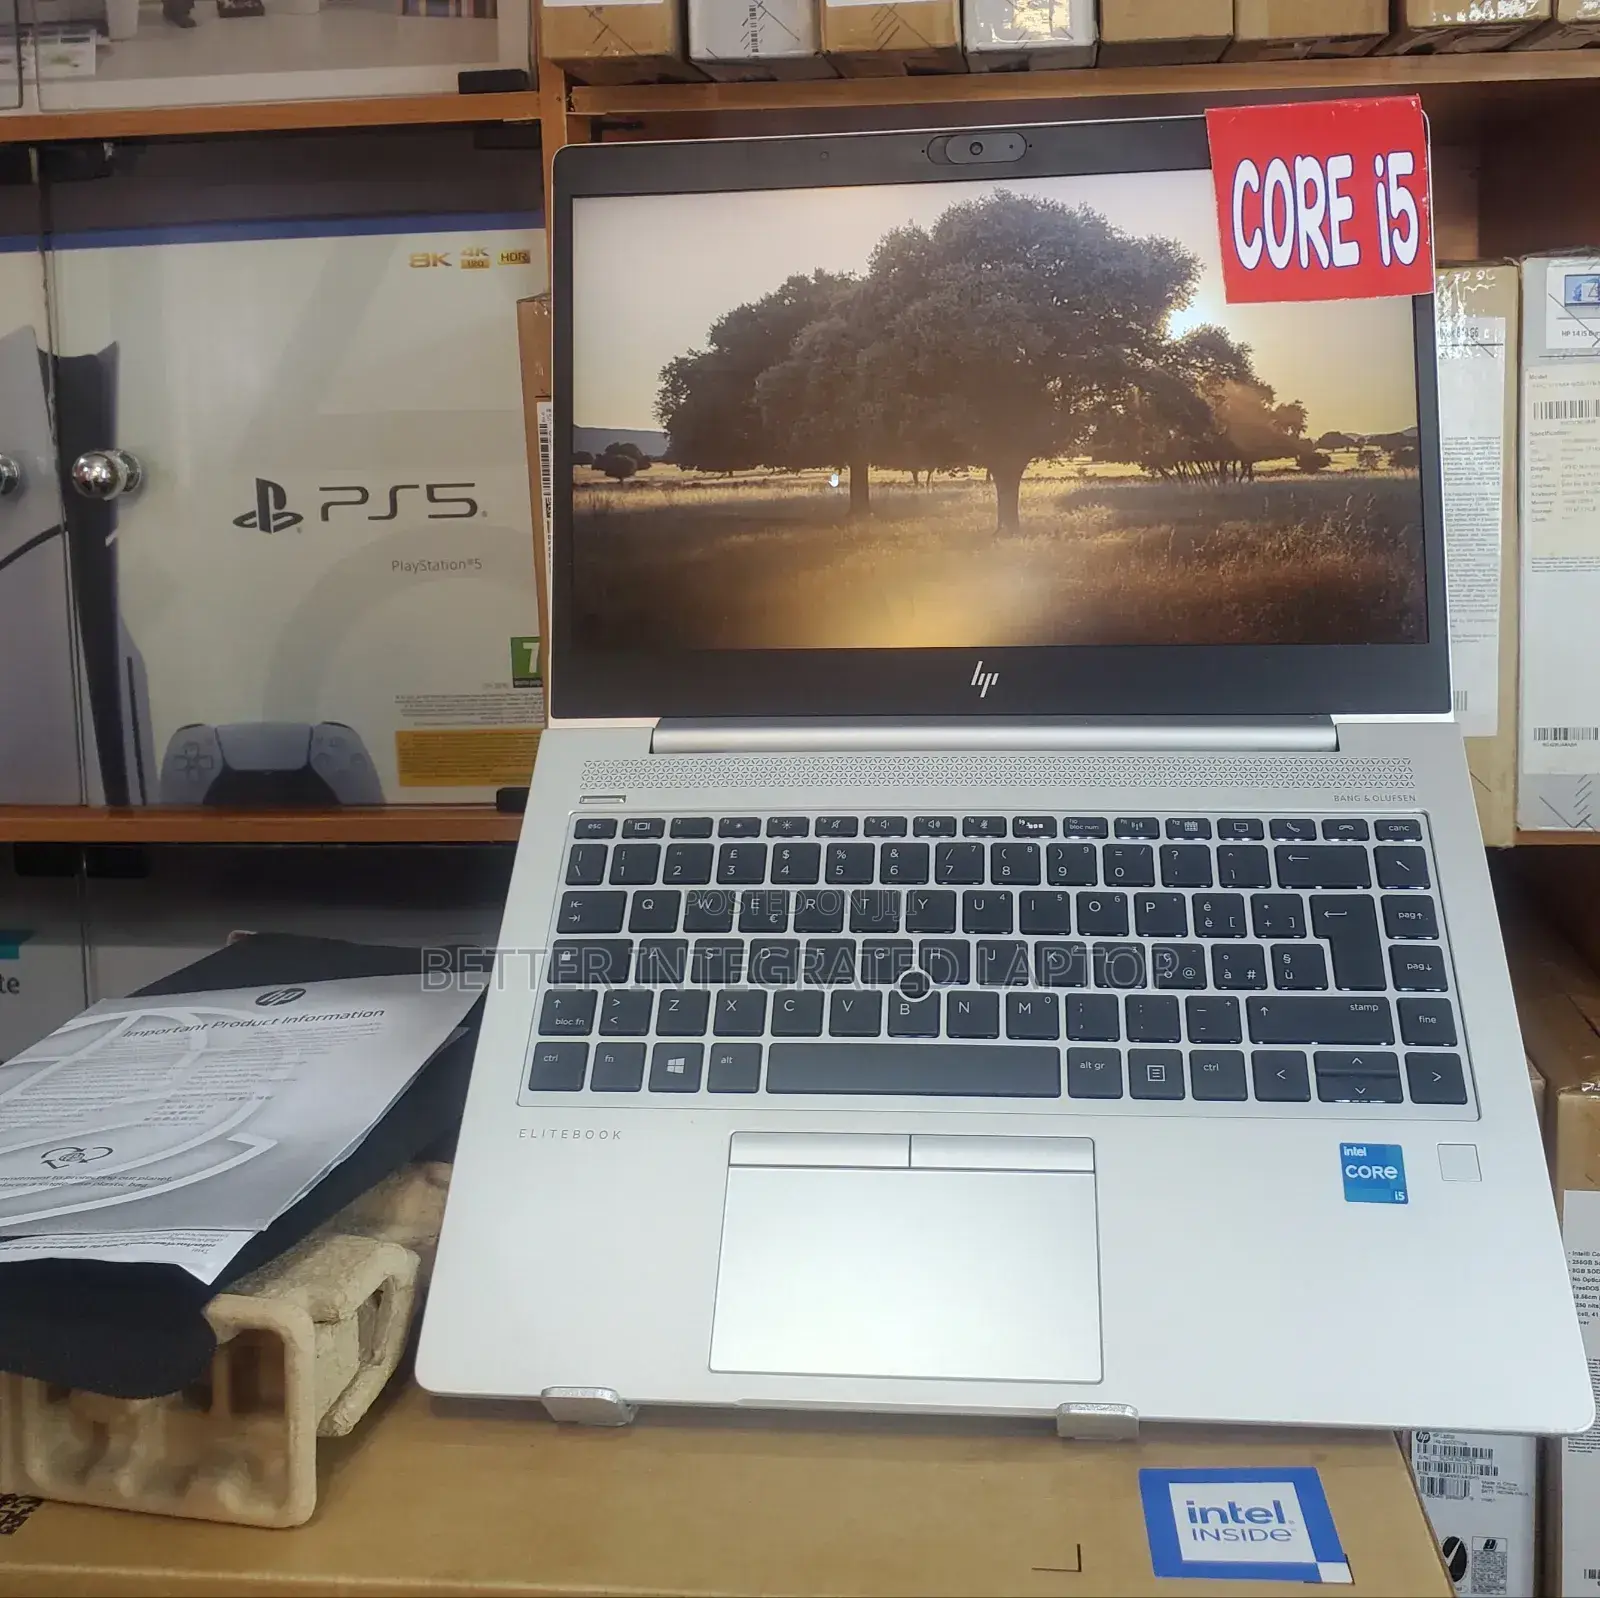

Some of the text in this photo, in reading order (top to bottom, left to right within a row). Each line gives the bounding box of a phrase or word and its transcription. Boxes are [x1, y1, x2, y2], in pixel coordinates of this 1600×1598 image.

[1231, 151, 1420, 270] CORE i5
[409, 252, 452, 268] 8K
[501, 252, 527, 262] HDR
[319, 483, 479, 522] PS5
[522, 642, 540, 674] 7
[1334, 794, 1360, 802] BANG
[1363, 794, 1371, 802] &
[730, 850, 737, 858] £
[783, 850, 789, 859] $
[837, 850, 846, 859] %
[891, 849, 898, 857] &
[1172, 851, 1178, 859] ?
[621, 867, 624, 875] 1
[673, 866, 681, 875] 2
[727, 866, 735, 874] 3
[781, 866, 789, 874] 4
[836, 866, 843, 874] 5
[891, 865, 898, 874] 6
[946, 866, 953, 874] 7
[1003, 866, 1010, 875] 8
[1059, 867, 1066, 876] 9
[642, 899, 653, 909] Q
[698, 899, 713, 910] W
[751, 898, 760, 910] E
[806, 898, 816, 910] R
[861, 898, 870, 910] T
[915, 899, 928, 912] Y
[975, 900, 984, 910] U
[1146, 902, 1155, 912] P
[769, 914, 778, 923] €
[648, 948, 660, 959] A
[704, 948, 714, 960] S
[760, 948, 771, 959] D
[816, 948, 825, 960] F
[874, 948, 885, 960] G
[930, 948, 941, 959] H
[988, 950, 996, 961] J
[1047, 951, 1058, 963] K
[1106, 952, 1115, 963] L
[1283, 954, 1291, 963] §
[1183, 967, 1195, 979] @
[1224, 969, 1231, 978] à
[1248, 970, 1255, 979] #
[1285, 970, 1293, 979] ù
[669, 1000, 679, 1010] Z
[727, 1000, 736, 1011] X
[784, 1000, 794, 1011] C
[843, 1000, 853, 1011] V
[900, 1004, 910, 1014] B
[959, 1002, 969, 1013] N
[1019, 1003, 1030, 1014] M
[121, 1007, 388, 1038] Important Product Information
[519, 1128, 622, 1140] ELITEBOOK
[1343, 1146, 1368, 1157] intel
[1394, 1191, 1405, 1201] i5
[1186, 1499, 1286, 1525] intel
